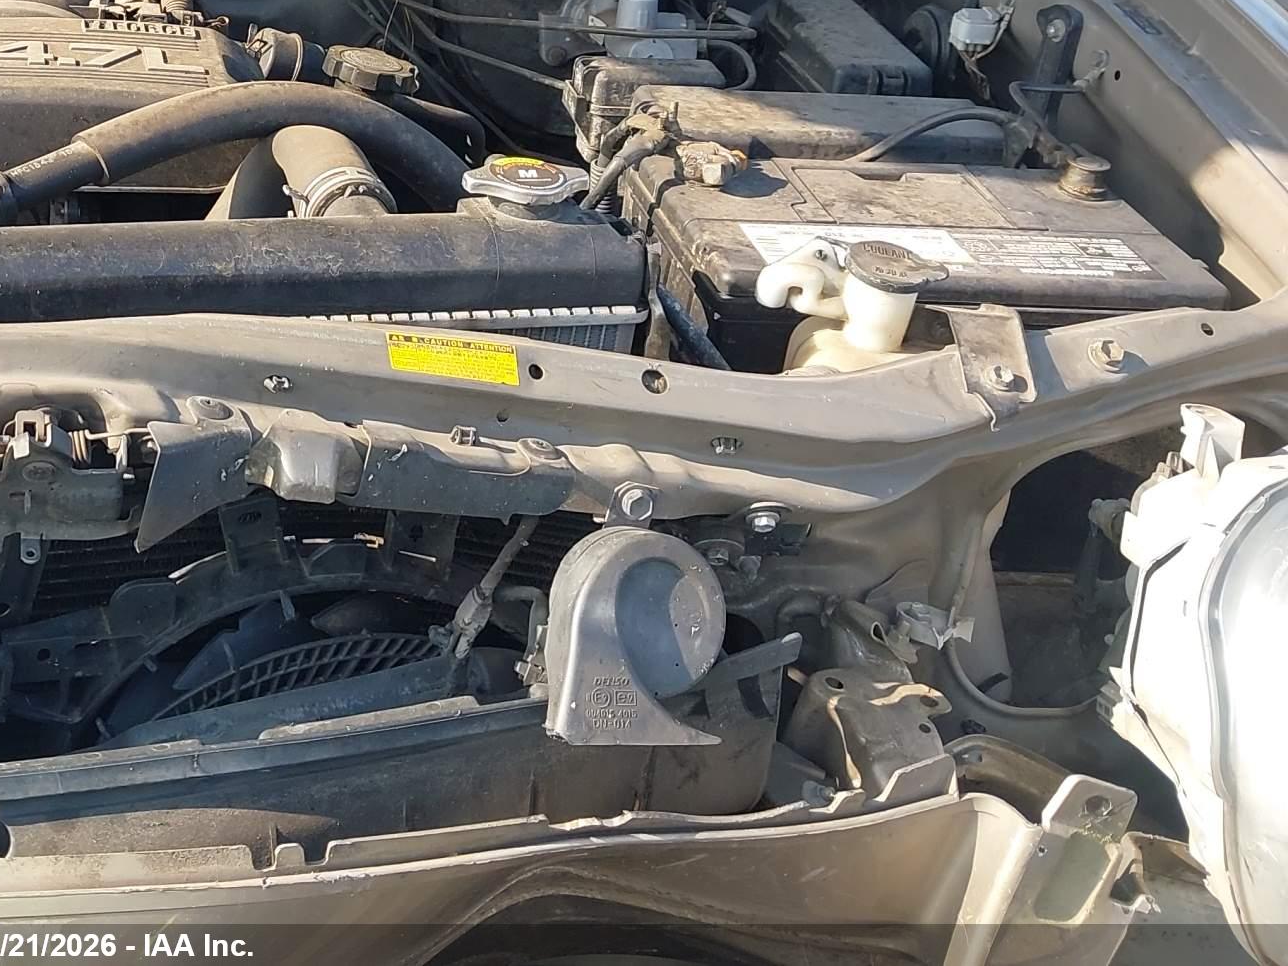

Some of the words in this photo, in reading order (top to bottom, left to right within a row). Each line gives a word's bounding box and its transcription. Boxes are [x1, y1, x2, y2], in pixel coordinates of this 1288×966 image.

[862, 242, 912, 260] COOLANT
[423, 338, 464, 349] CAUTION
[469, 342, 513, 354] ATTENTION
